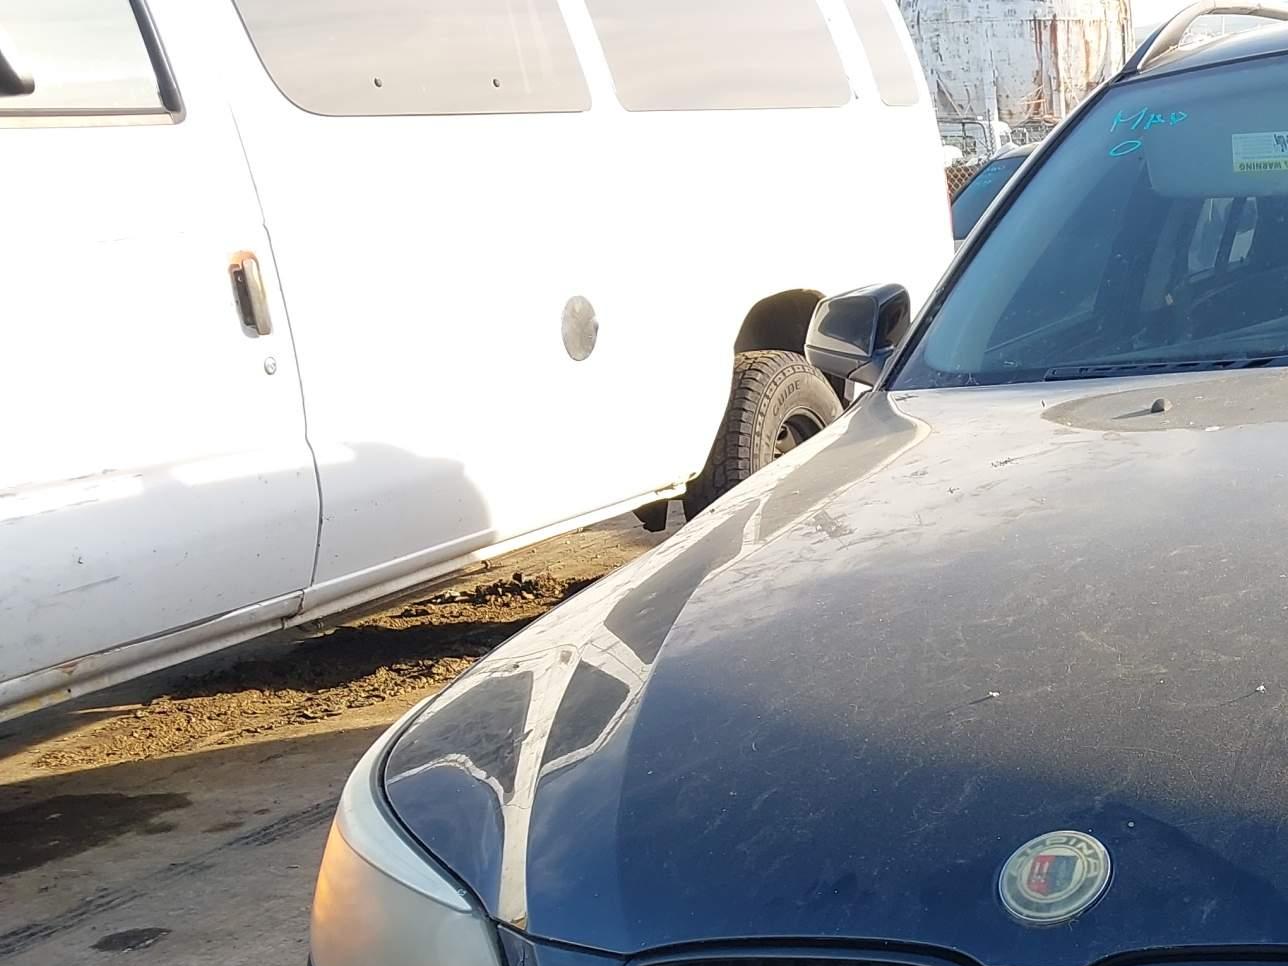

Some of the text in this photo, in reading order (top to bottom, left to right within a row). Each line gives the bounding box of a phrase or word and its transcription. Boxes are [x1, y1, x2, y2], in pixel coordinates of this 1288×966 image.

[1239, 160, 1282, 171] WARNING
[772, 379, 801, 417] GUIDE
[1010, 835, 1099, 878] ALPINA
